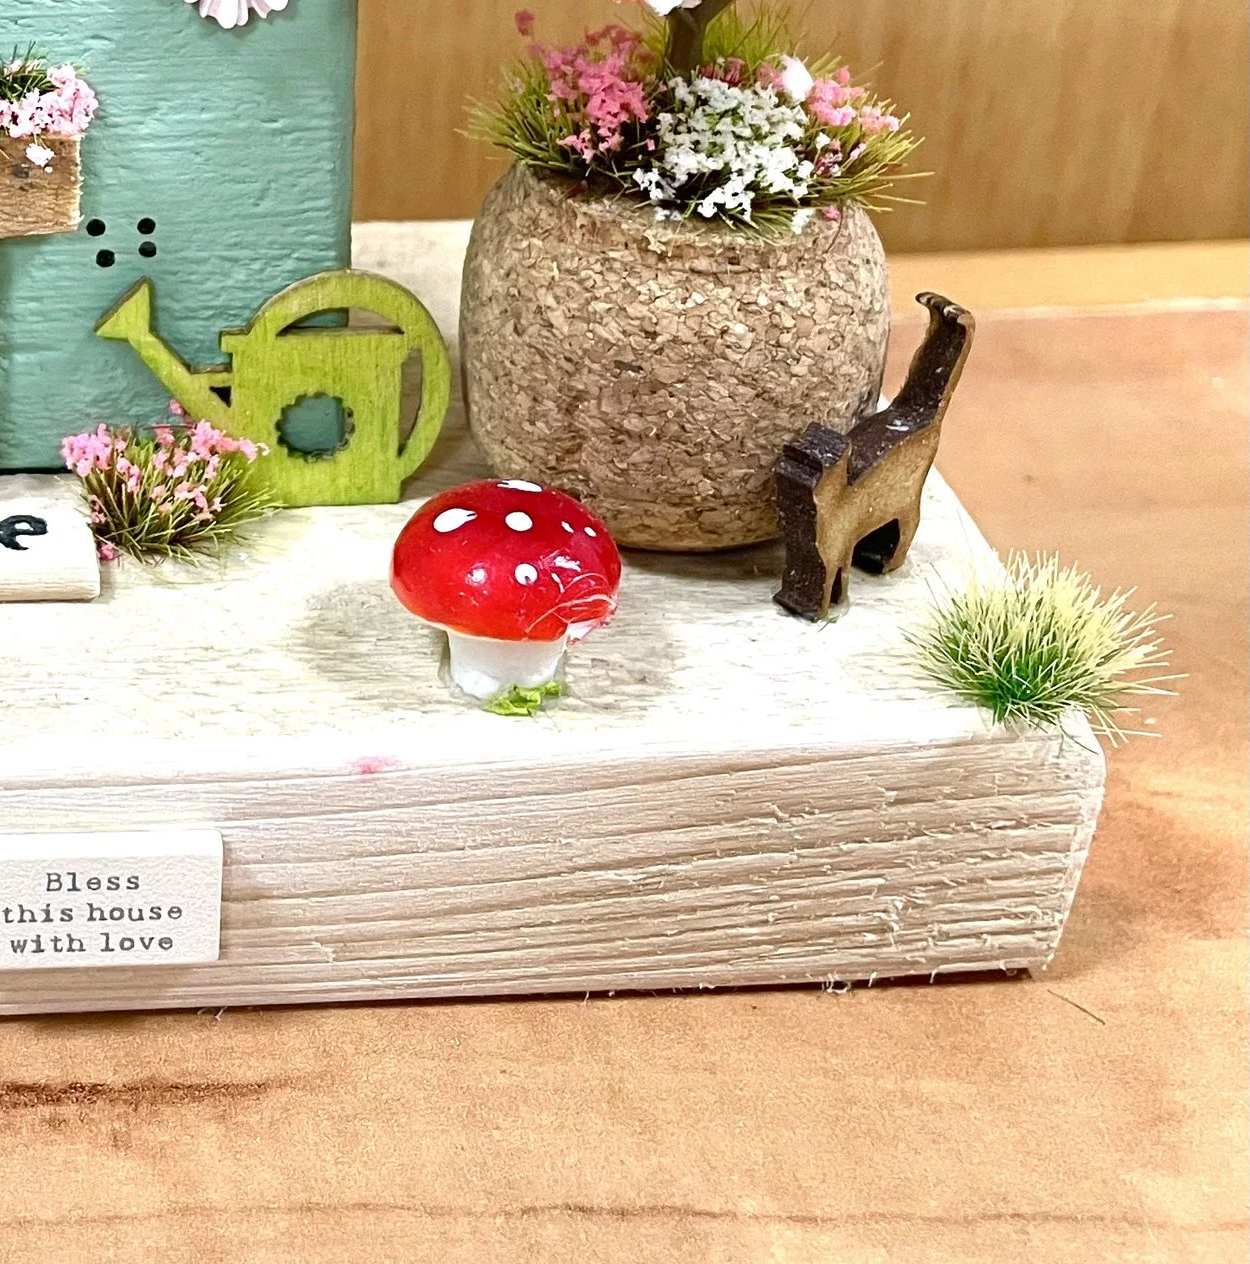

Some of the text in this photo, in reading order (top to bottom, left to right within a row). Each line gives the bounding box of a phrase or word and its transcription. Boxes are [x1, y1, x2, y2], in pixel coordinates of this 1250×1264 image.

[46, 872, 140, 892] Bless
[2, 902, 183, 923] this house
[10, 932, 174, 954] with love
